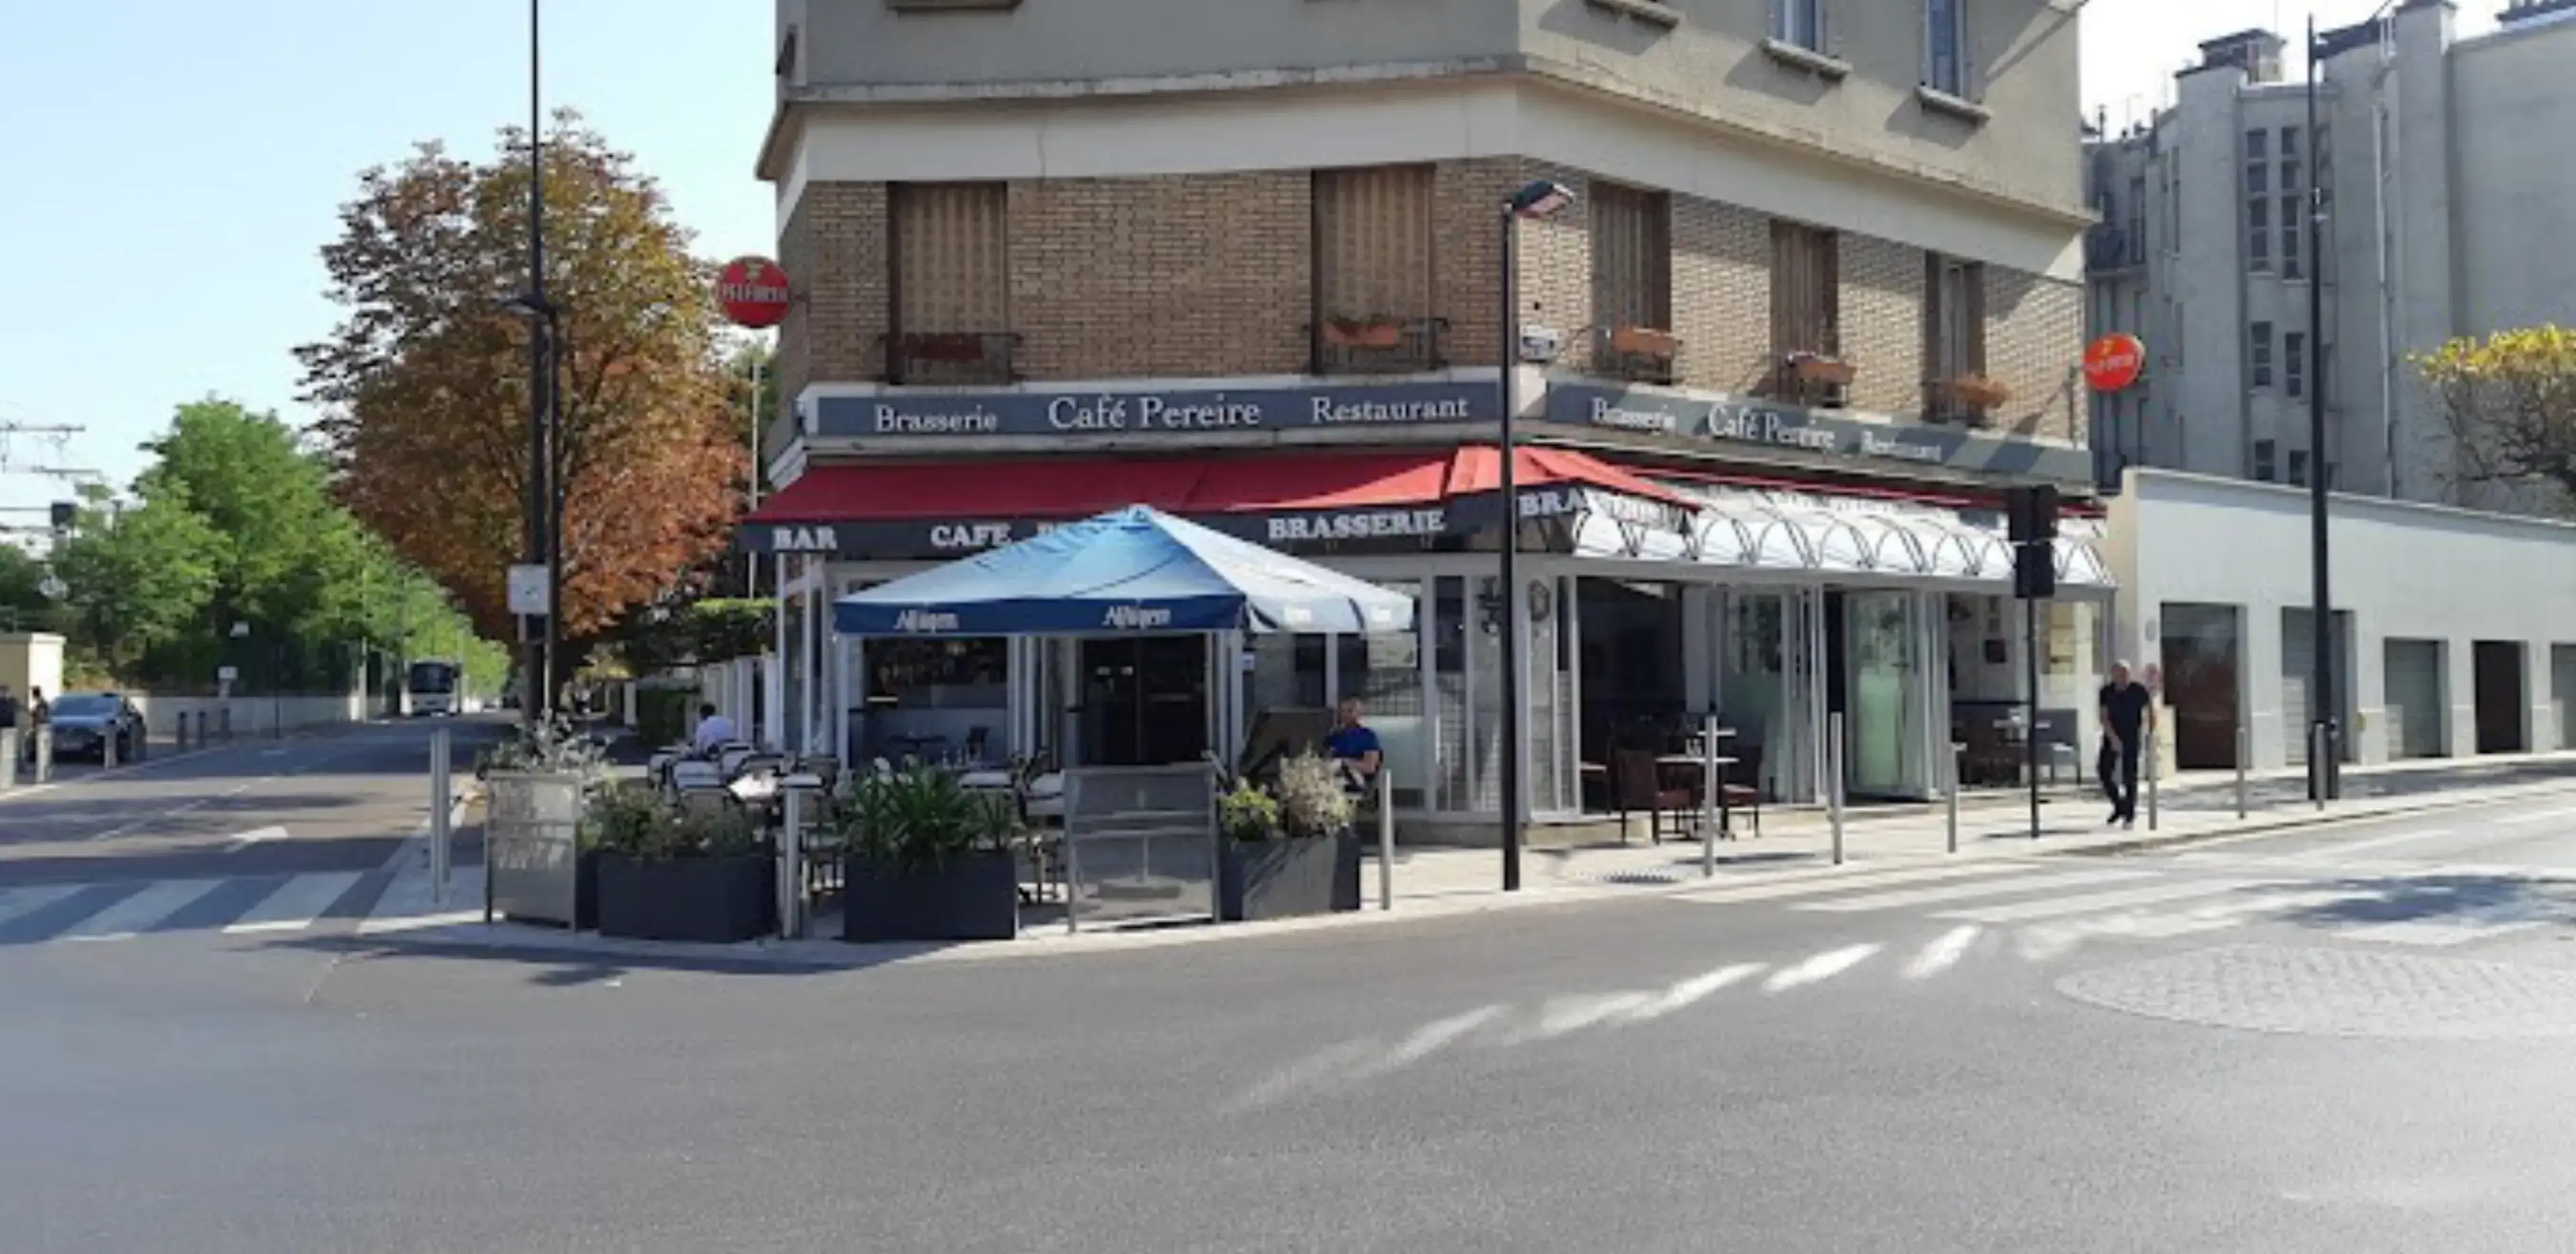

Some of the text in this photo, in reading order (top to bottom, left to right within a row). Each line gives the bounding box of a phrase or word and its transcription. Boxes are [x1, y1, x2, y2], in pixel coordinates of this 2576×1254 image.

[874, 391, 1469, 433] Brasserie Café Pereire Restaurant
[771, 525, 837, 551] BAR
[1268, 510, 1445, 541] BRASSERIE
